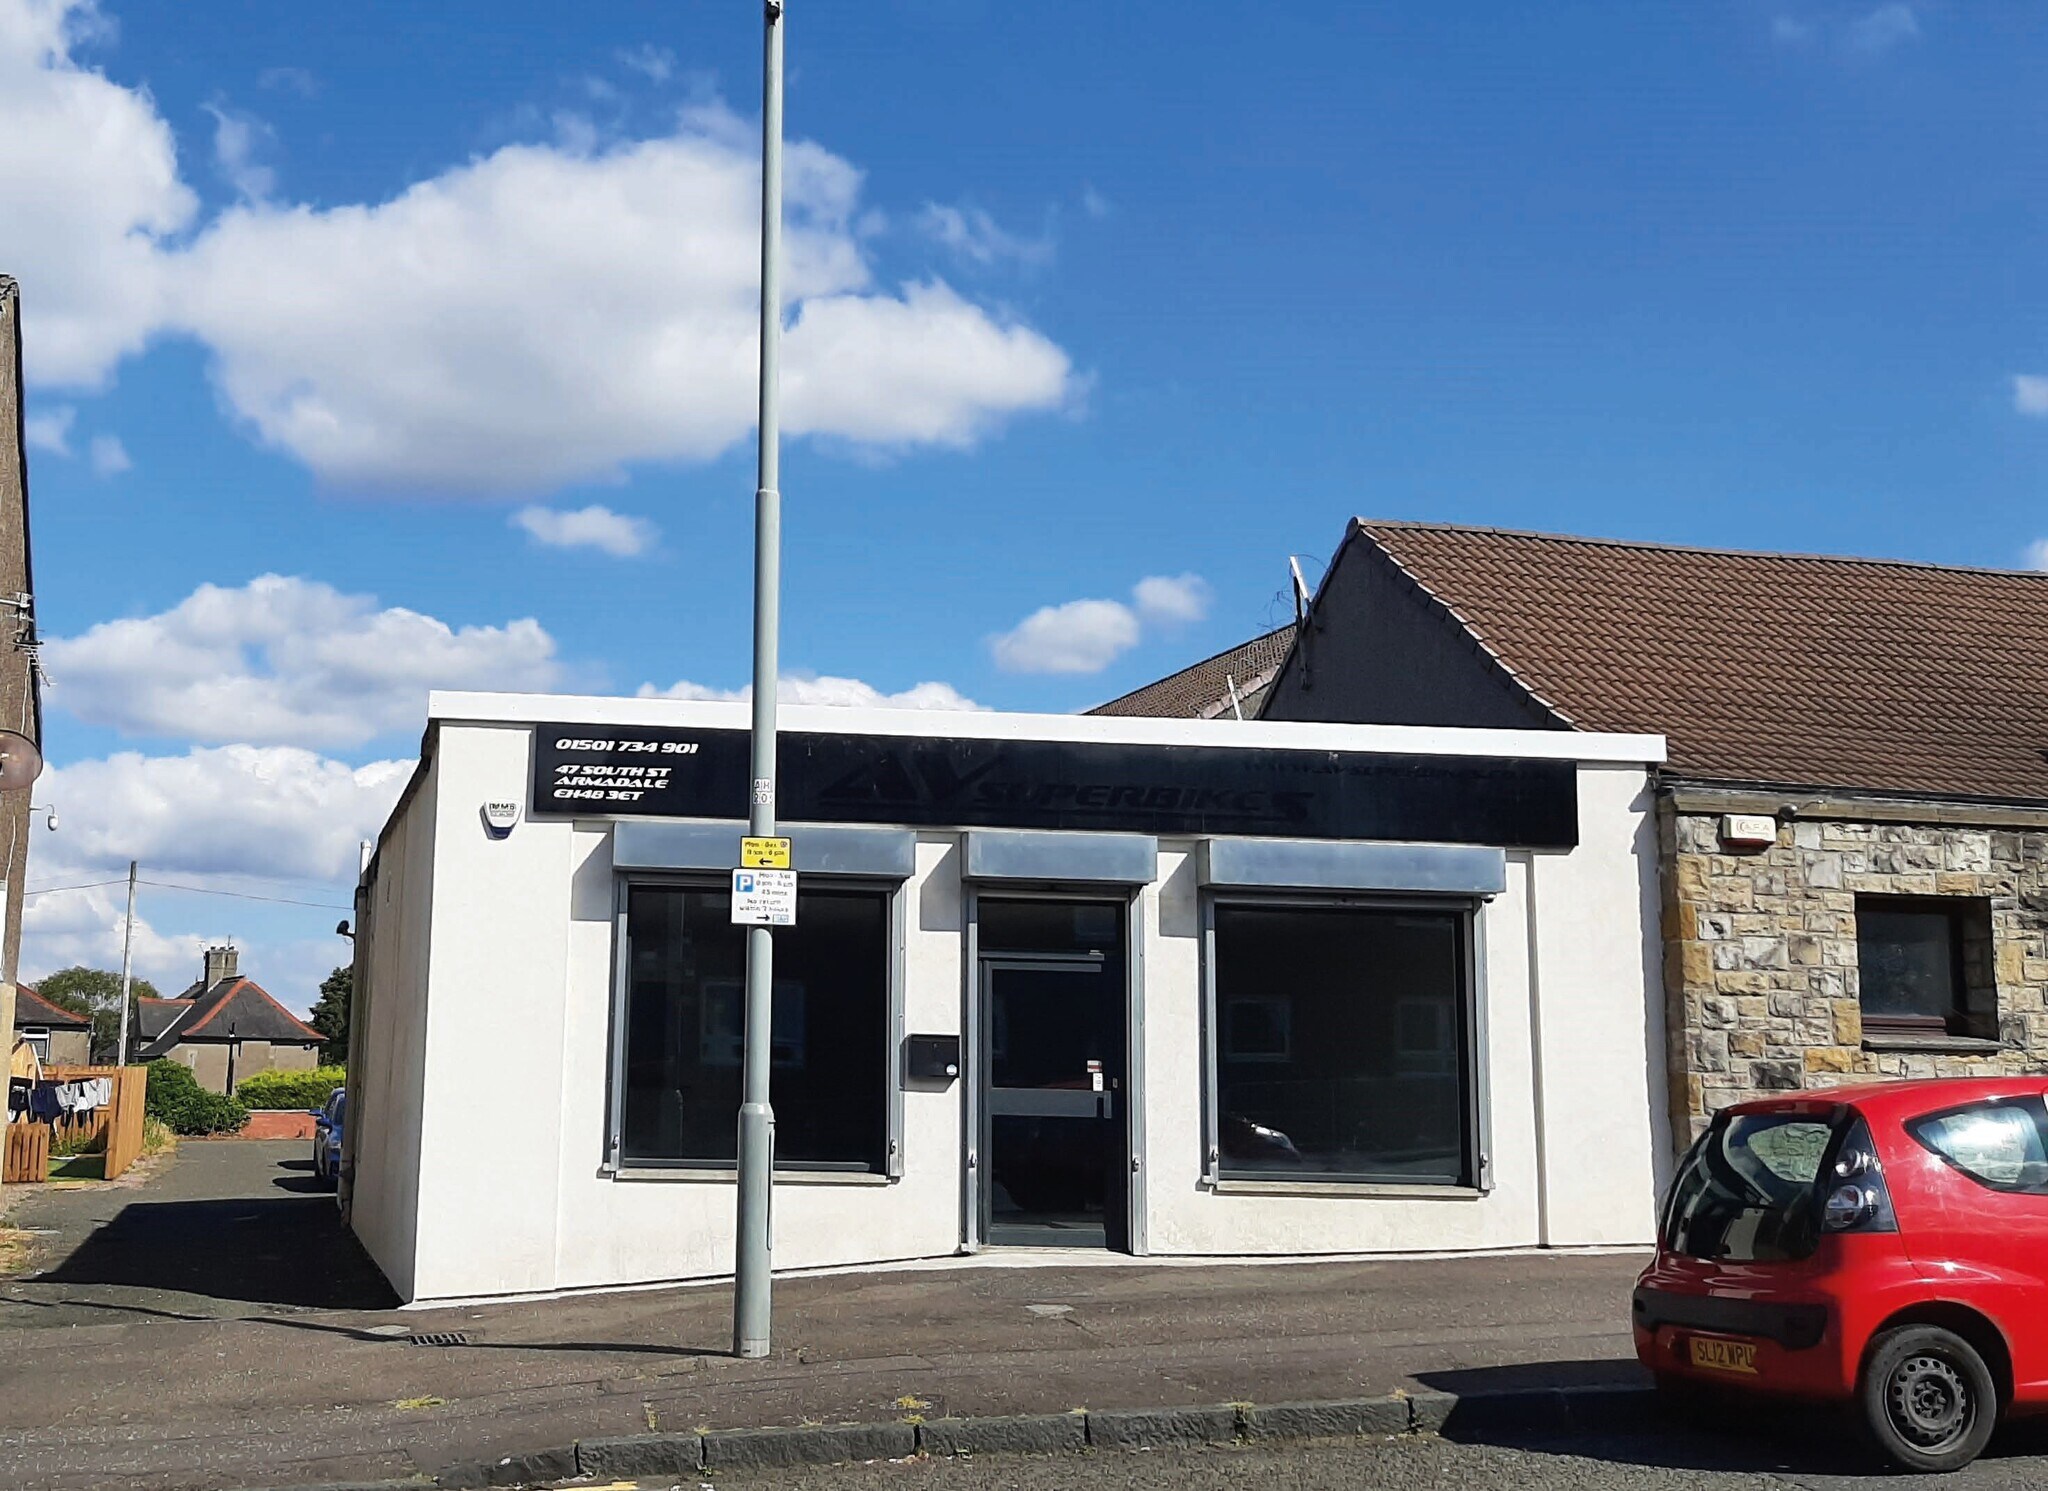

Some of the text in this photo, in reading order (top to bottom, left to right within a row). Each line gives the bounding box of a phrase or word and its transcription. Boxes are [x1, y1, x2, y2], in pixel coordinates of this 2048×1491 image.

[555, 739, 699, 754] 01501 734 901
[554, 765, 672, 777] 47 SOUTH ST
[554, 776, 669, 788] ARMADALE
[553, 788, 644, 800] EH48 3ET
[1697, 1340, 1726, 1363] SL12
